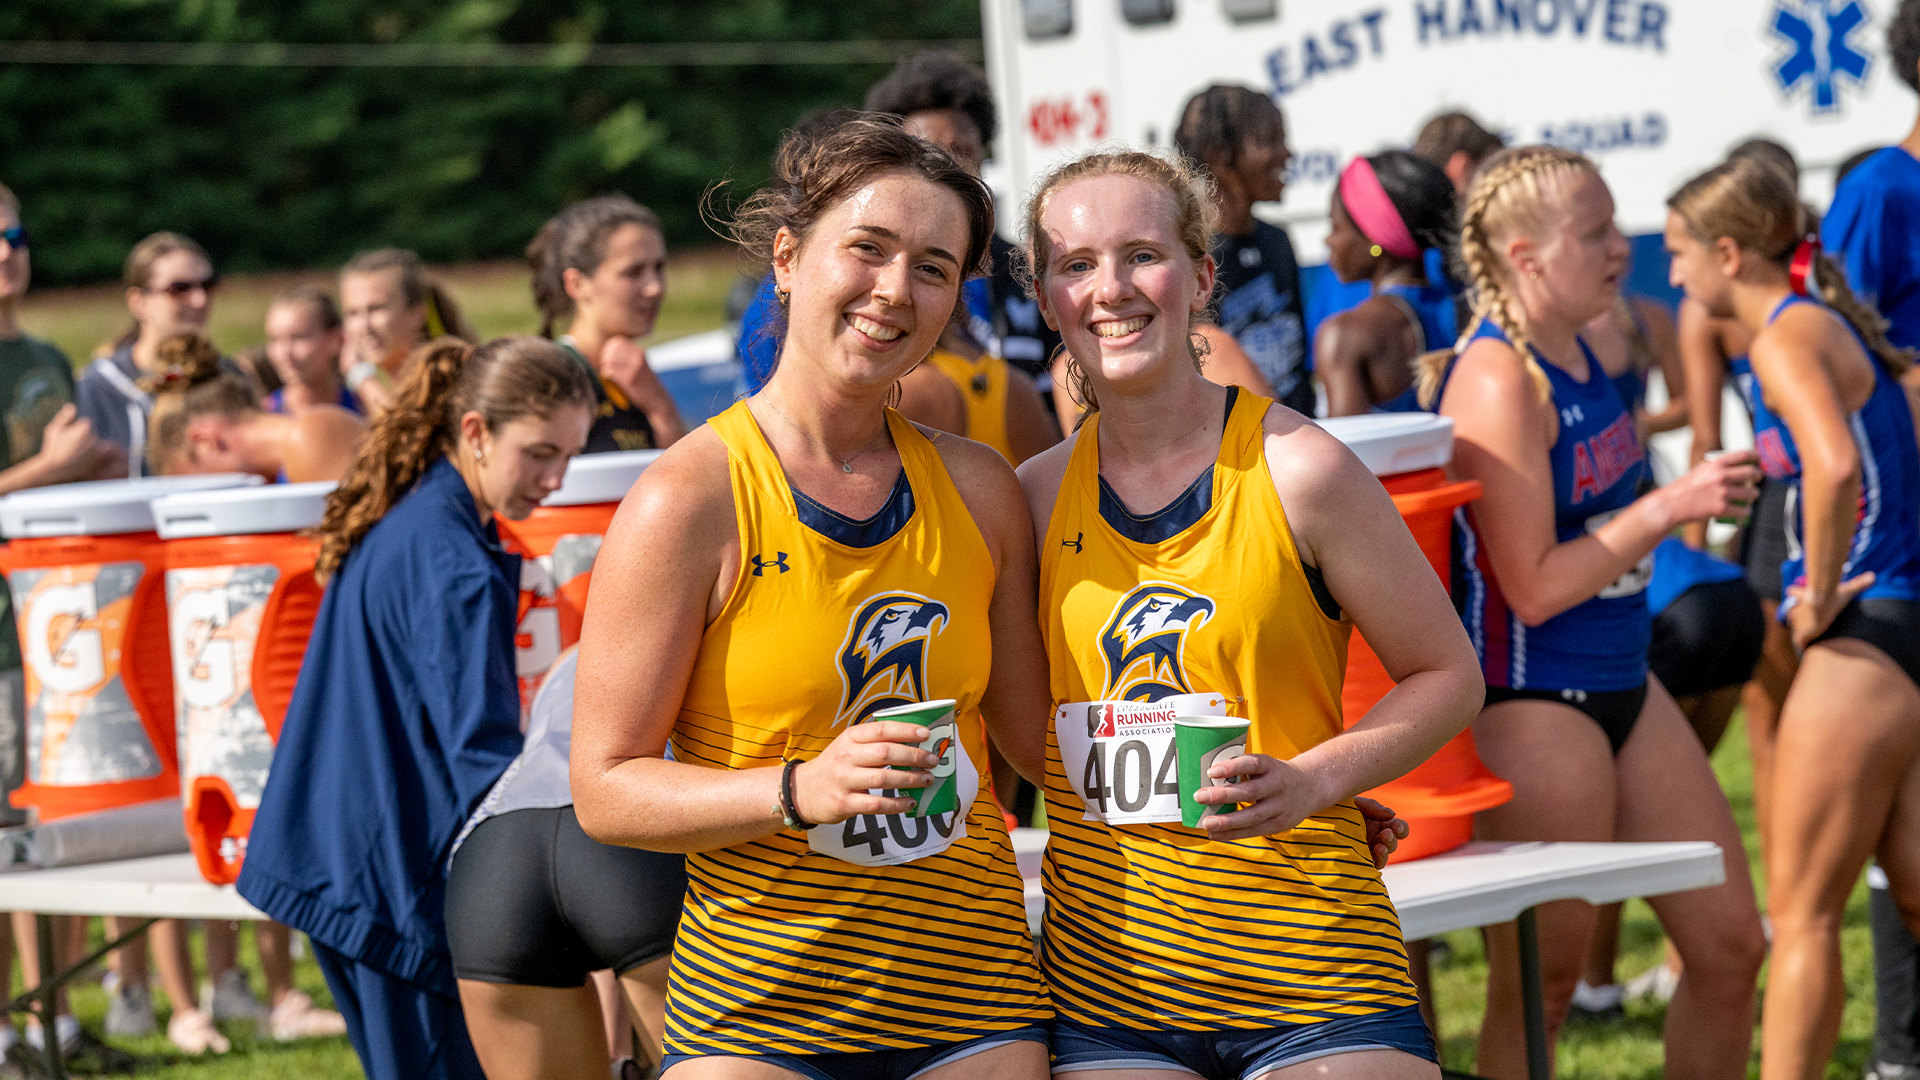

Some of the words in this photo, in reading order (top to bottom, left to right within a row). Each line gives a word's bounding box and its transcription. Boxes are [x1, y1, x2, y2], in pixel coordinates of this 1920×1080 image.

[1266, 10, 1387, 98] EAST
[1415, 0, 1668, 53] HANOVER
[26, 581, 107, 693] G
[171, 586, 237, 709] G
[1116, 710, 1177, 726] RUNNING
[1084, 737, 1182, 814] 404
